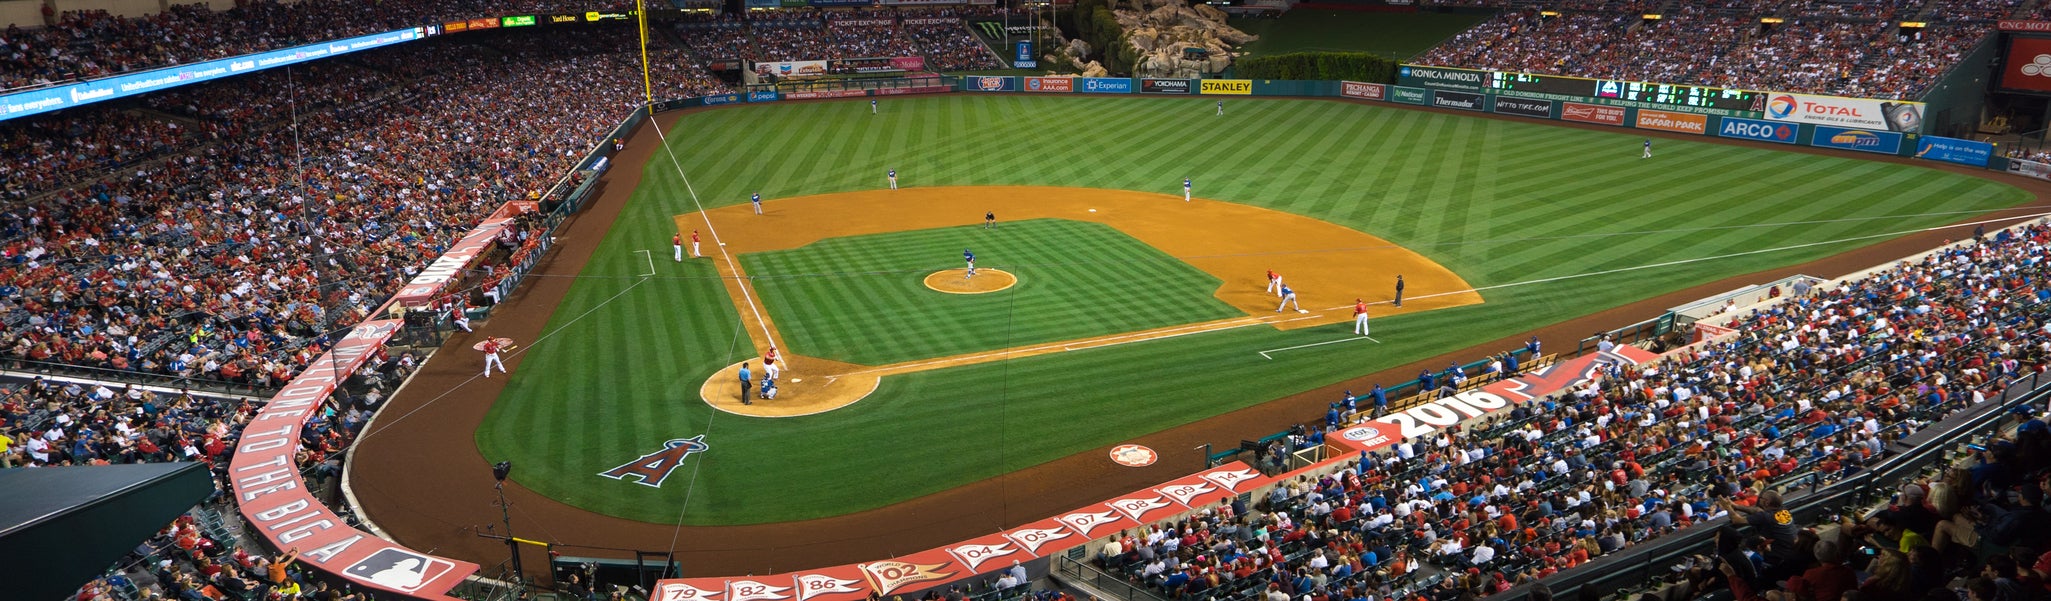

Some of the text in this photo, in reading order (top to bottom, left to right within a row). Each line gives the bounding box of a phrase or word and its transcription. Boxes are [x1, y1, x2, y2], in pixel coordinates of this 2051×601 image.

[2000, 21, 2023, 29] CNC
[1411, 69, 1443, 79] KONICA
[1444, 71, 1480, 82] MINOLTA
[1099, 82, 1127, 90] Experian
[1202, 83, 1250, 91] STANLEY
[1346, 84, 1380, 92] PECHANGA
[705, 96, 726, 104] Corona
[1436, 97, 1474, 108] Thermador
[1545, 93, 1569, 101] FREIGHT
[1610, 100, 1637, 108] HELPING
[1652, 103, 1675, 111] WORLD
[1694, 107, 1729, 116] PROMISES
[1804, 102, 1862, 117] TOTAL
[1640, 117, 1702, 130] SAFARI PARK
[1724, 122, 1773, 138] ARCO
[1830, 135, 1880, 148] ampm
[1376, 389, 1506, 440] 2016
[1349, 428, 1367, 437] FOX
[1361, 435, 1391, 447] WEST
[235, 344, 371, 564] WELCOME TO THE BIG A
[887, 575, 928, 588] CHAMPIONS
